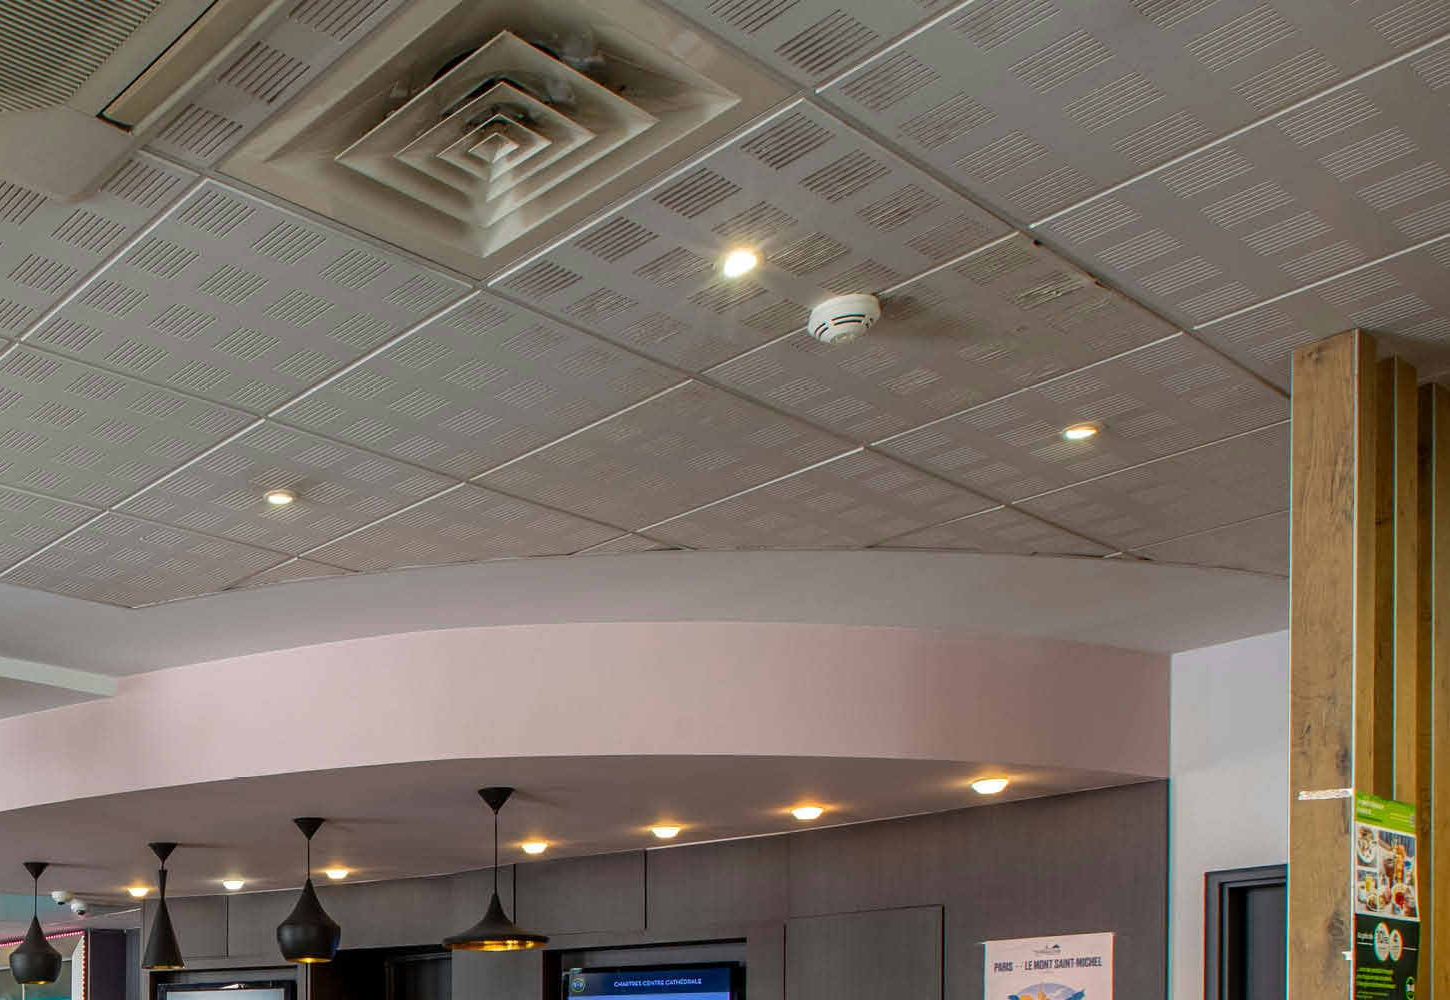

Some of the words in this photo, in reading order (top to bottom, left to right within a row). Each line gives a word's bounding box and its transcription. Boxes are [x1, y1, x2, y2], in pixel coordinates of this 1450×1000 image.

[993, 961, 1013, 973] PARIS
[1024, 960, 1033, 970] LE
[1034, 958, 1053, 969] MONT
